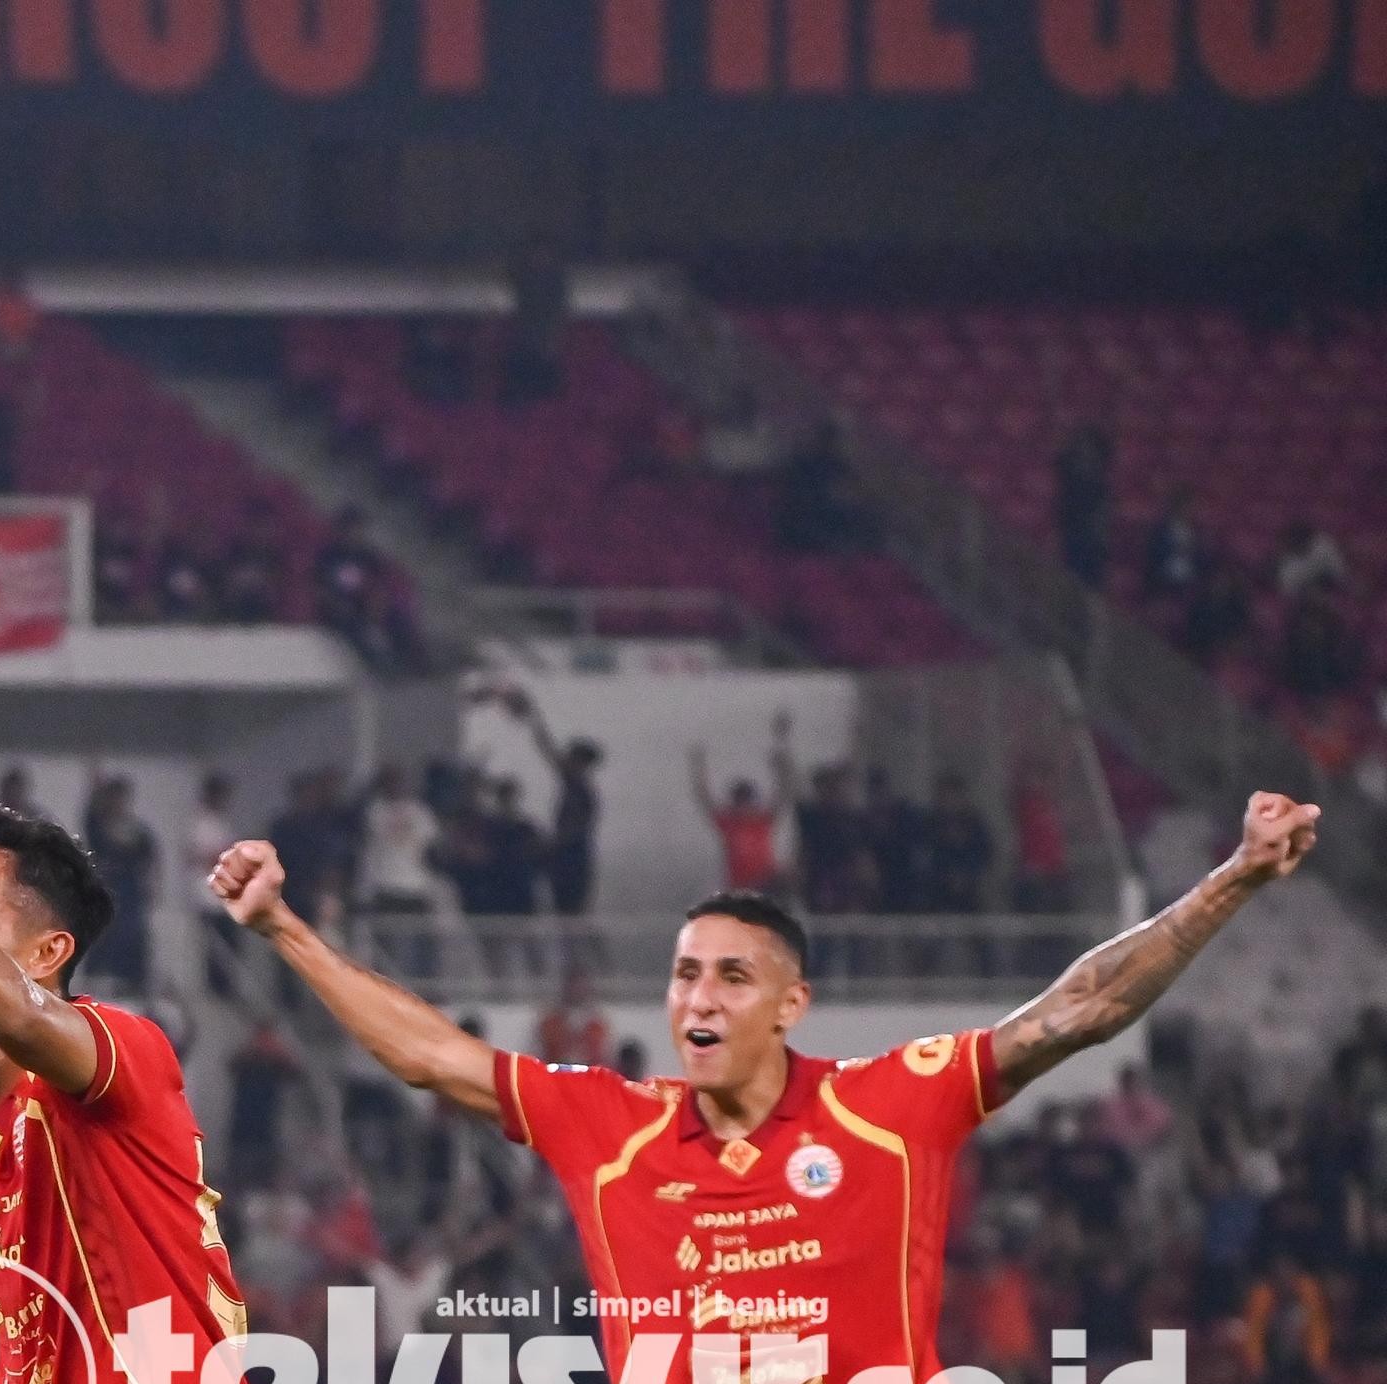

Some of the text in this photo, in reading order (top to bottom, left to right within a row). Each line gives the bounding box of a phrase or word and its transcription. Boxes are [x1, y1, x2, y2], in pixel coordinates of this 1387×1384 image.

[701, 1202, 800, 1229] PAM JAYA
[705, 1239, 823, 1274] Jakarta
